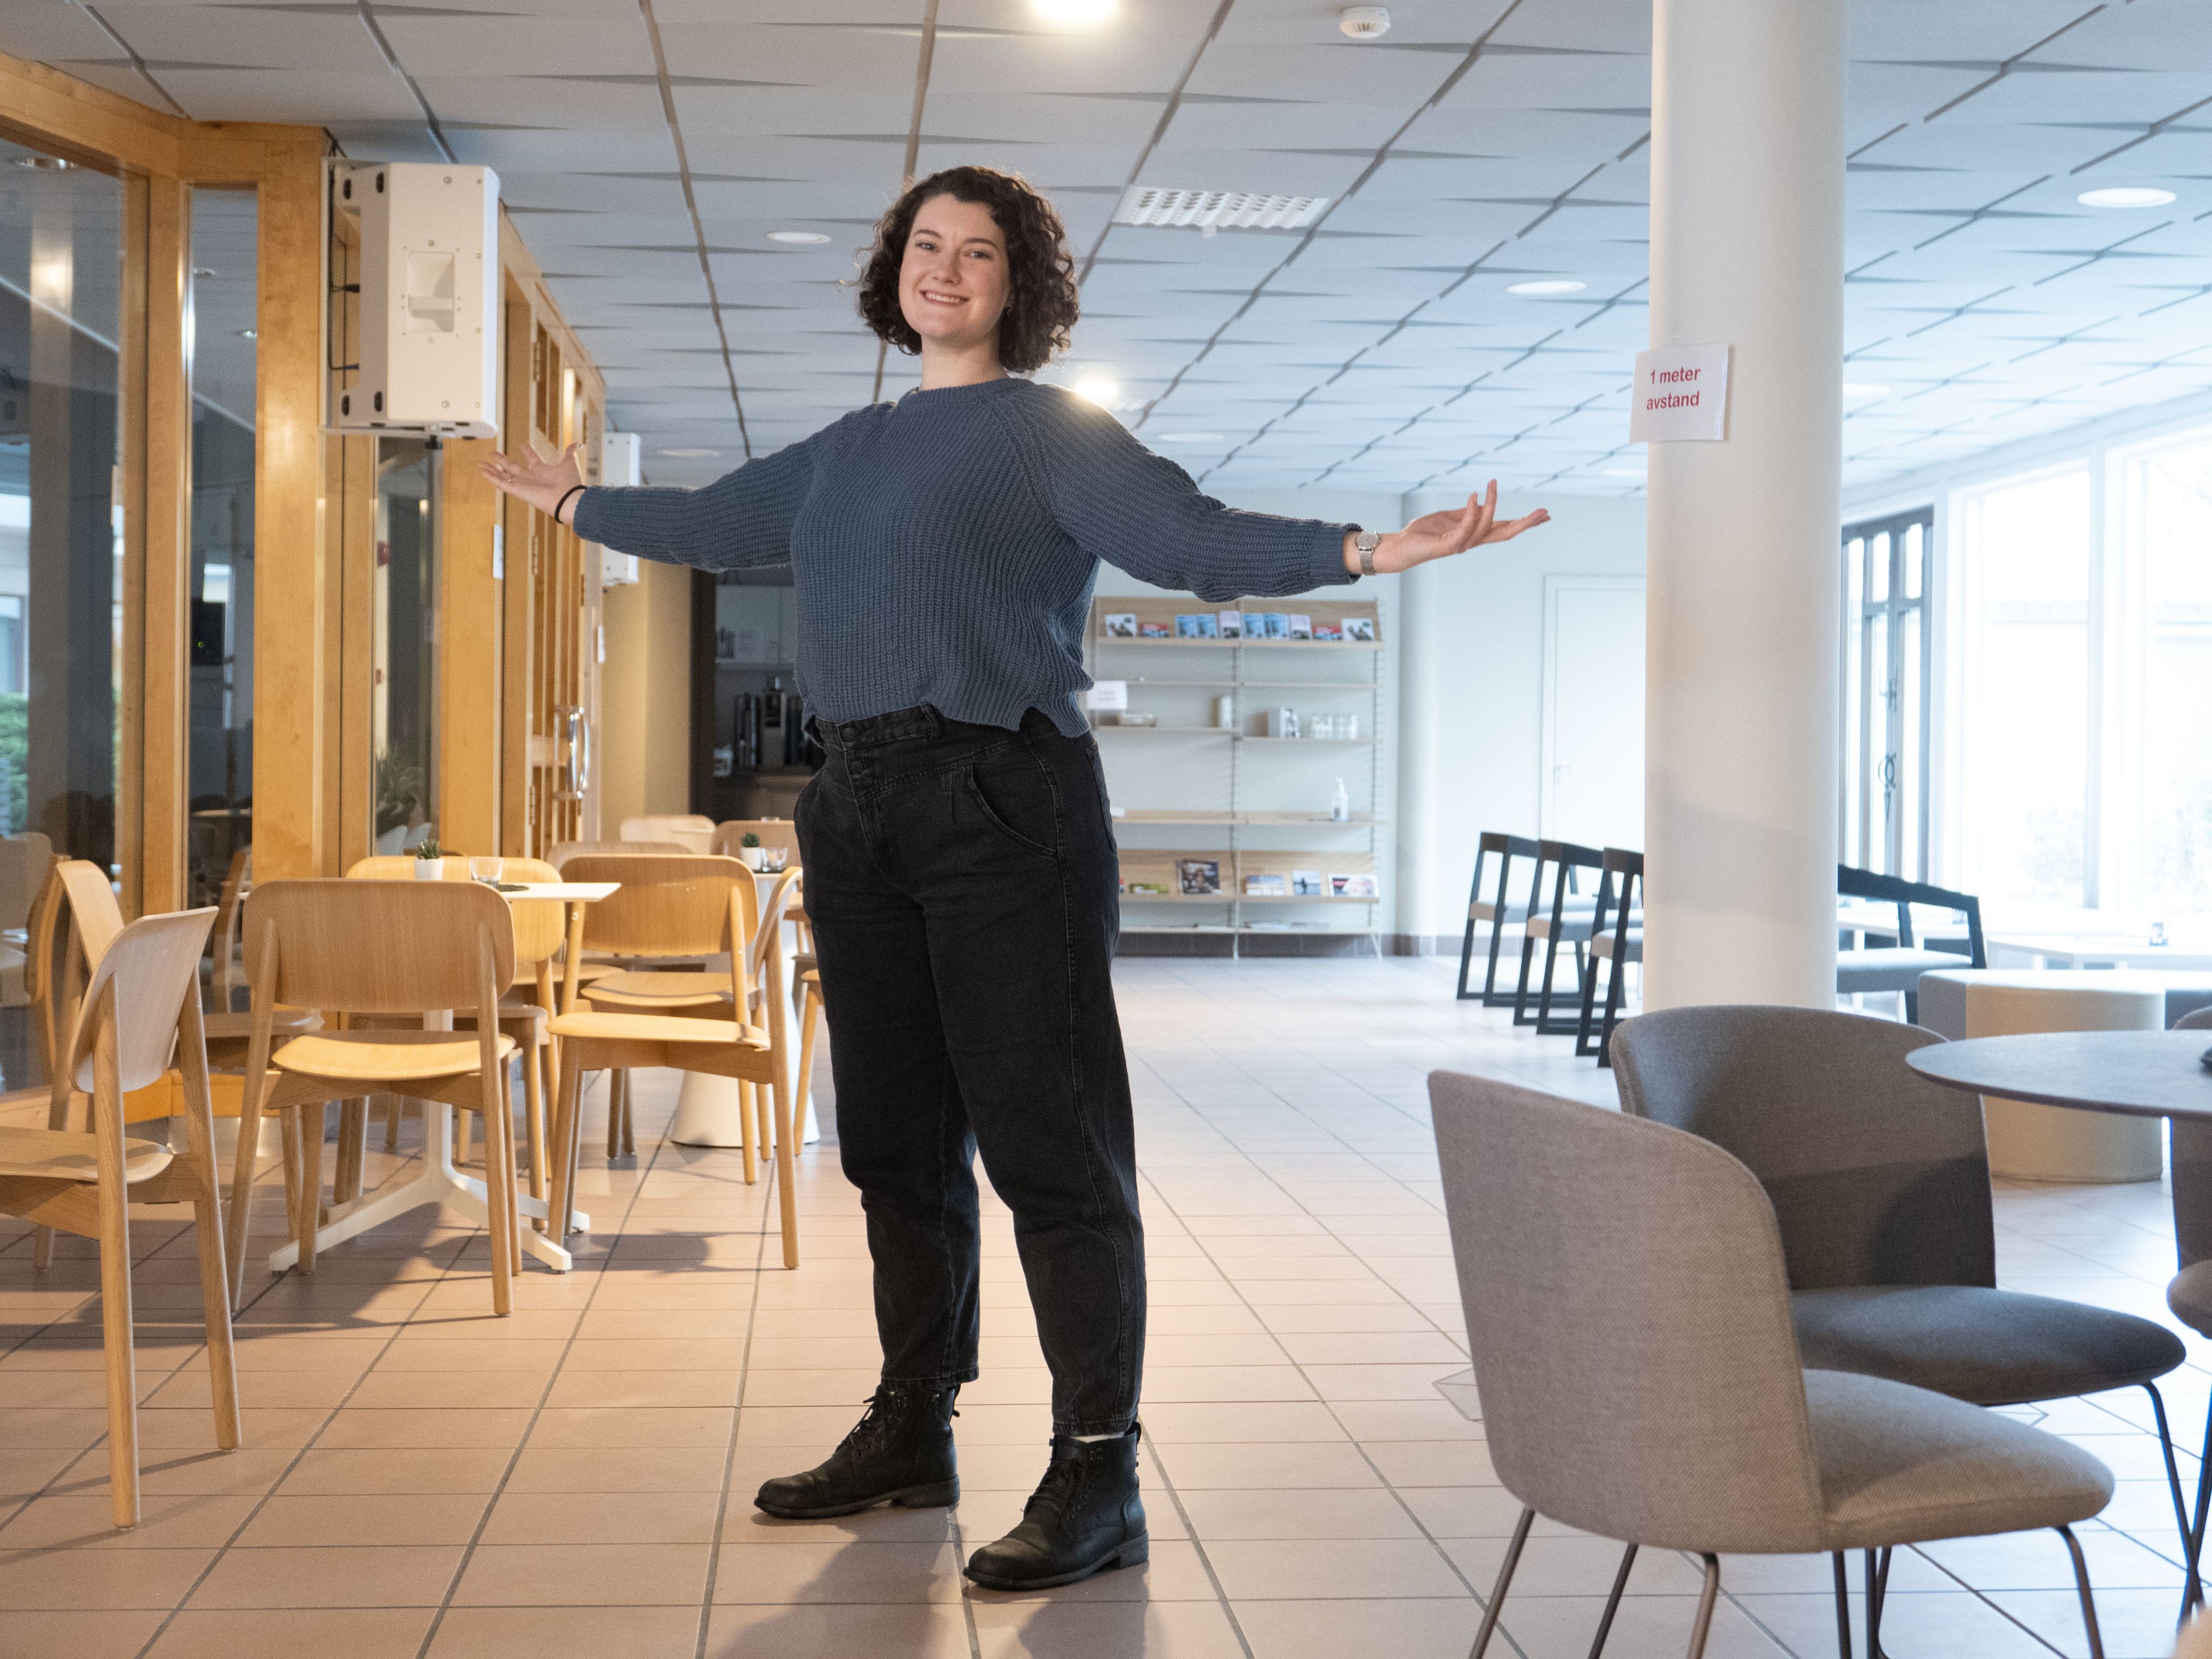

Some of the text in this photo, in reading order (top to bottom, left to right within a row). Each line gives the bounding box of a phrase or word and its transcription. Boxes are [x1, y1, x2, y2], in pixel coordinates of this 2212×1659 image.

[1650, 367, 1701, 385] 1 meter
[1647, 390, 1700, 410] avstand
